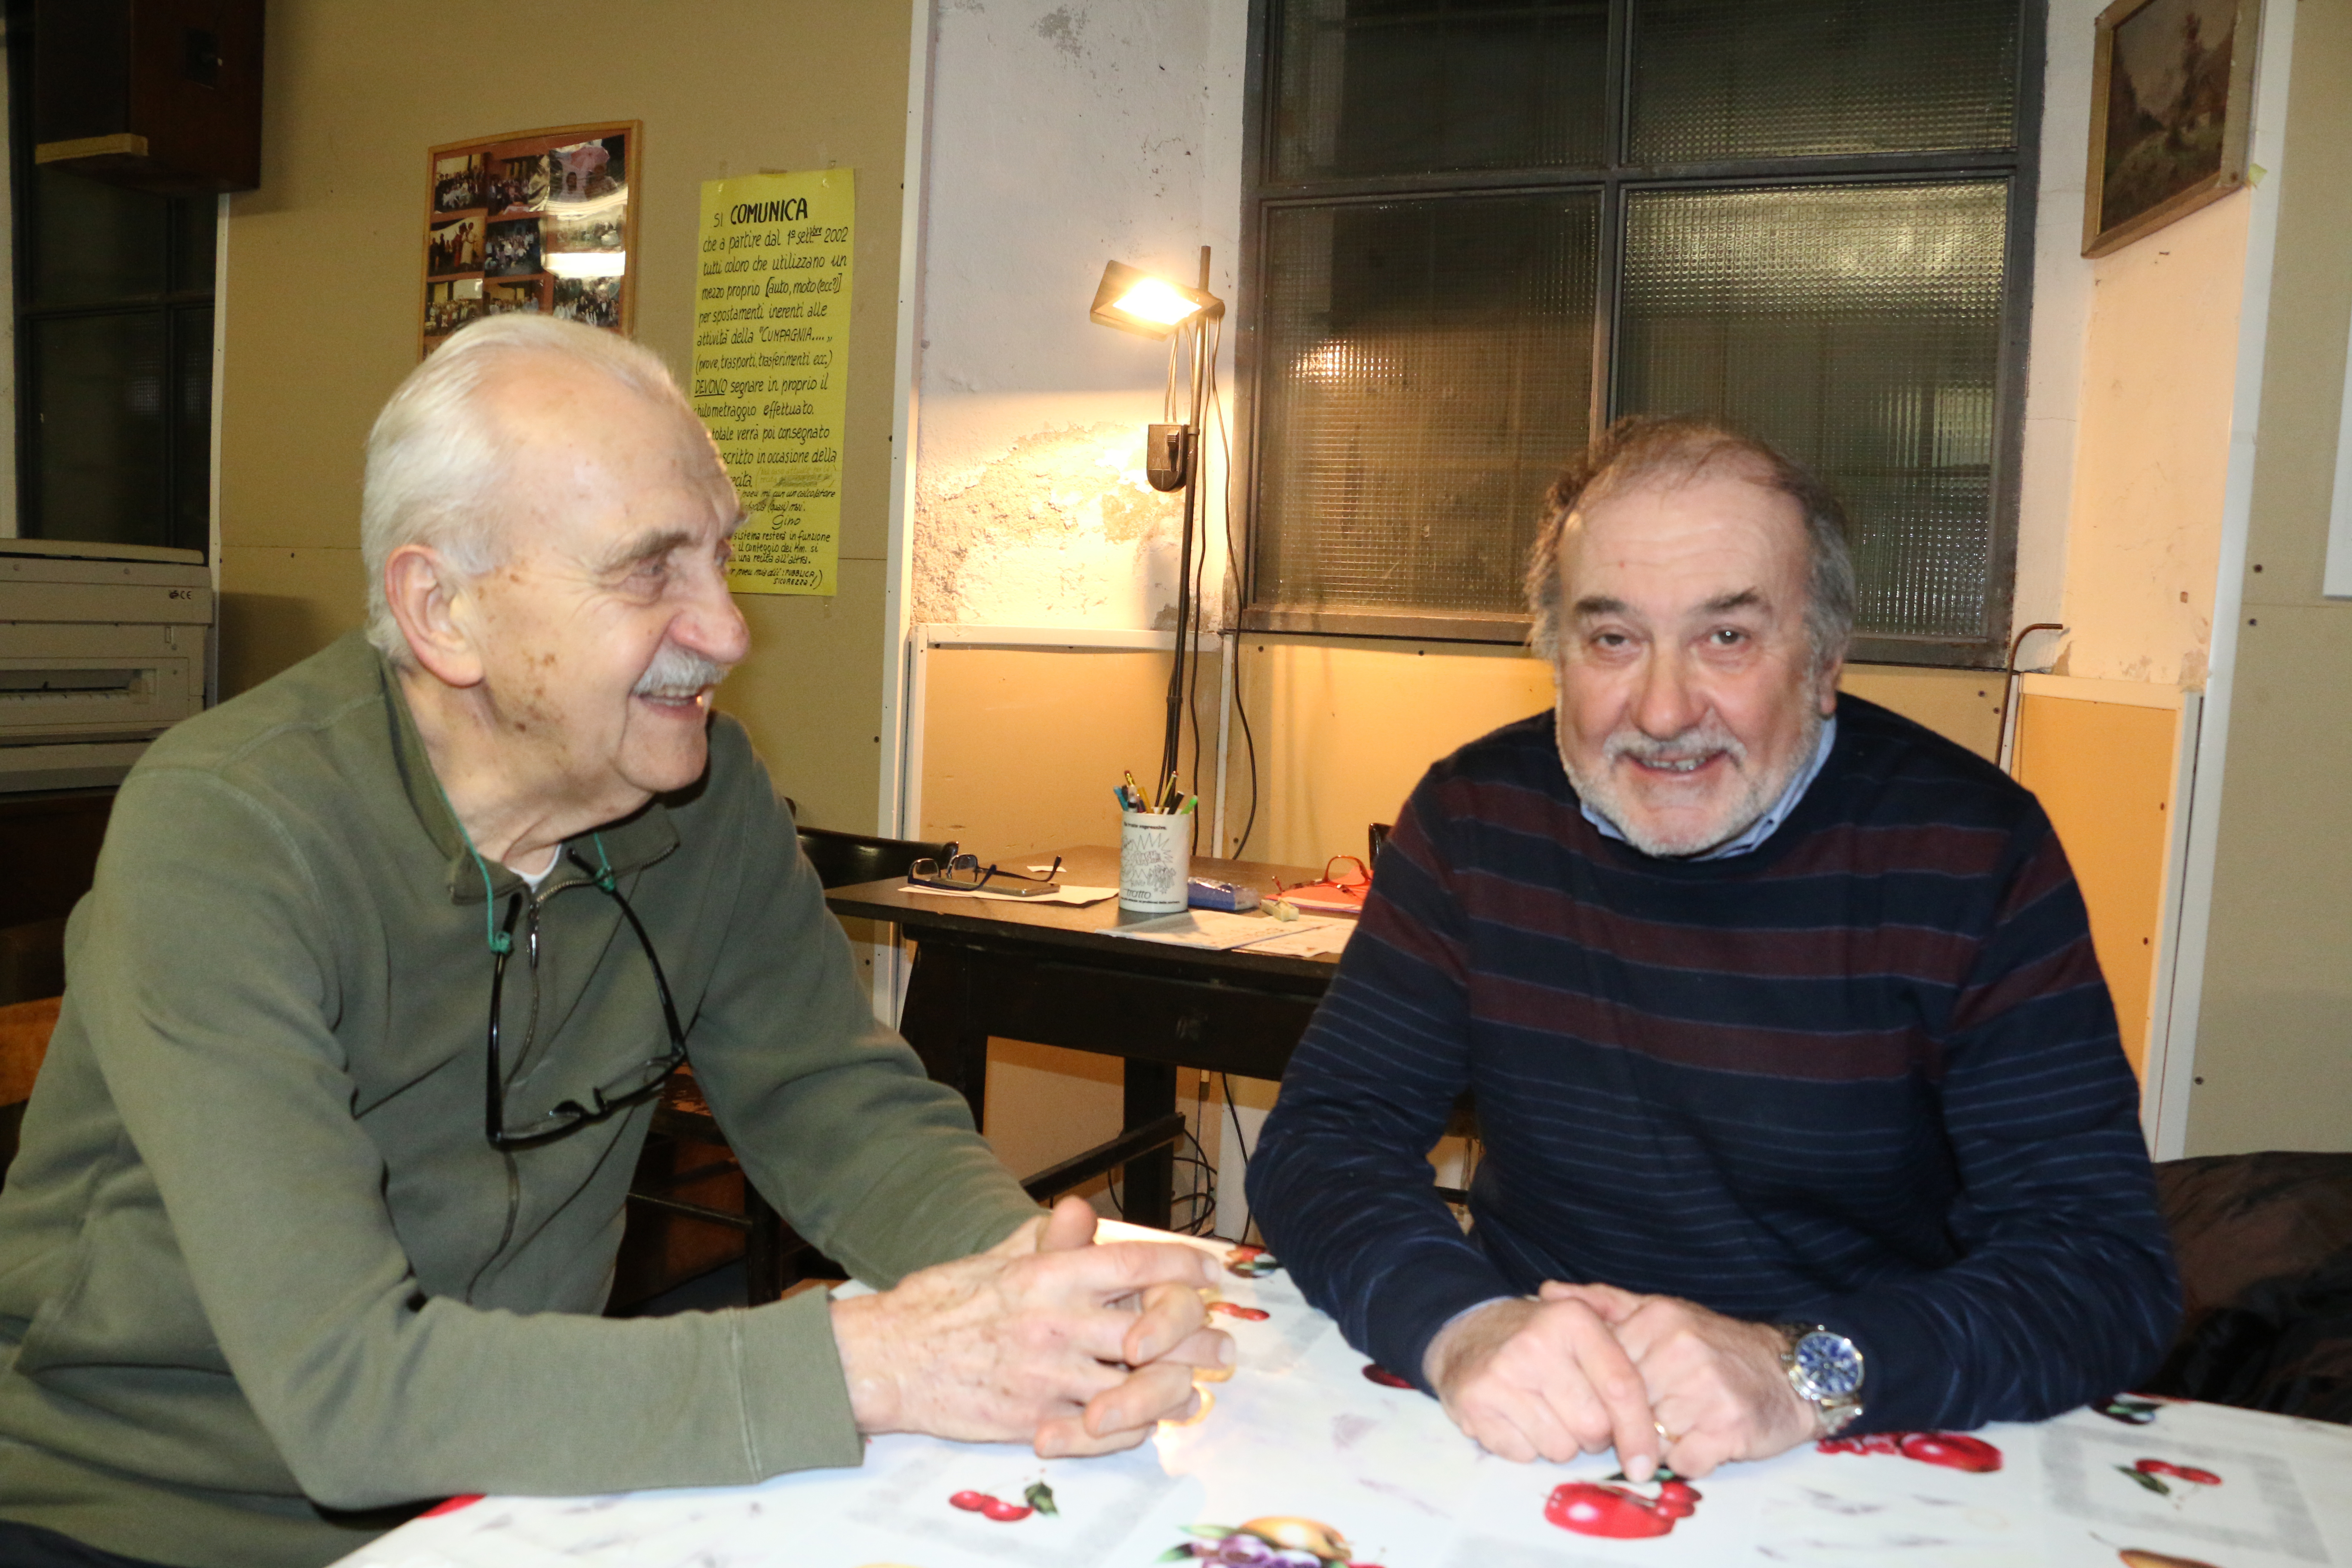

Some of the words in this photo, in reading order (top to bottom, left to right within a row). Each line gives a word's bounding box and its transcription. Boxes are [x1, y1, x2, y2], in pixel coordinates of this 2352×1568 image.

[714, 212, 723, 227] SI
[731, 198, 808, 224] COMUNICA
[703, 236, 716, 252] che
[720, 238, 725, 250] a
[729, 230, 760, 254] partire
[765, 229, 781, 246] dal
[824, 227, 848, 243] 2002
[704, 260, 722, 276] tutti
[725, 257, 749, 273] coloro
[753, 255, 767, 271] che
[772, 252, 825, 270] utilizzano
[831, 255, 846, 267] un
[702, 287, 723, 300] mezzo
[727, 280, 760, 300] proprio
[699, 312, 711, 328] per
[713, 303, 764, 325] spostamenti
[769, 302, 803, 318] inerenti
[807, 301, 827, 317] alle
[697, 329, 729, 346] attività
[731, 328, 753, 344] della
[696, 354, 720, 375] (prove,
[759, 352, 810, 369] trasferimenti
[813, 350, 833, 369] ecc.)
[695, 380, 727, 395] DEVONO
[731, 380, 763, 398] segnare
[768, 377, 778, 392] in
[782, 378, 817, 395] proprio
[821, 373, 828, 390] il
[764, 401, 814, 419] effettuato.
[712, 427, 733, 441] totale
[737, 424, 759, 440] verrà
[763, 427, 775, 442] poi
[778, 425, 830, 444] consegnato
[757, 448, 765, 463] in
[768, 449, 809, 463] occasione
[812, 447, 836, 463] della
[797, 489, 836, 498] calcolatore
[772, 515, 800, 530] Gino
[734, 530, 760, 540] sistema
[762, 531, 787, 540] resterà
[790, 531, 796, 540] in
[797, 530, 830, 542] funzione
[738, 542, 744, 551] il
[745, 542, 779, 555] conteggio
[781, 543, 792, 552] dei
[811, 543, 818, 552] si
[753, 554, 774, 563] recita
[181, 591, 191, 600] CE
